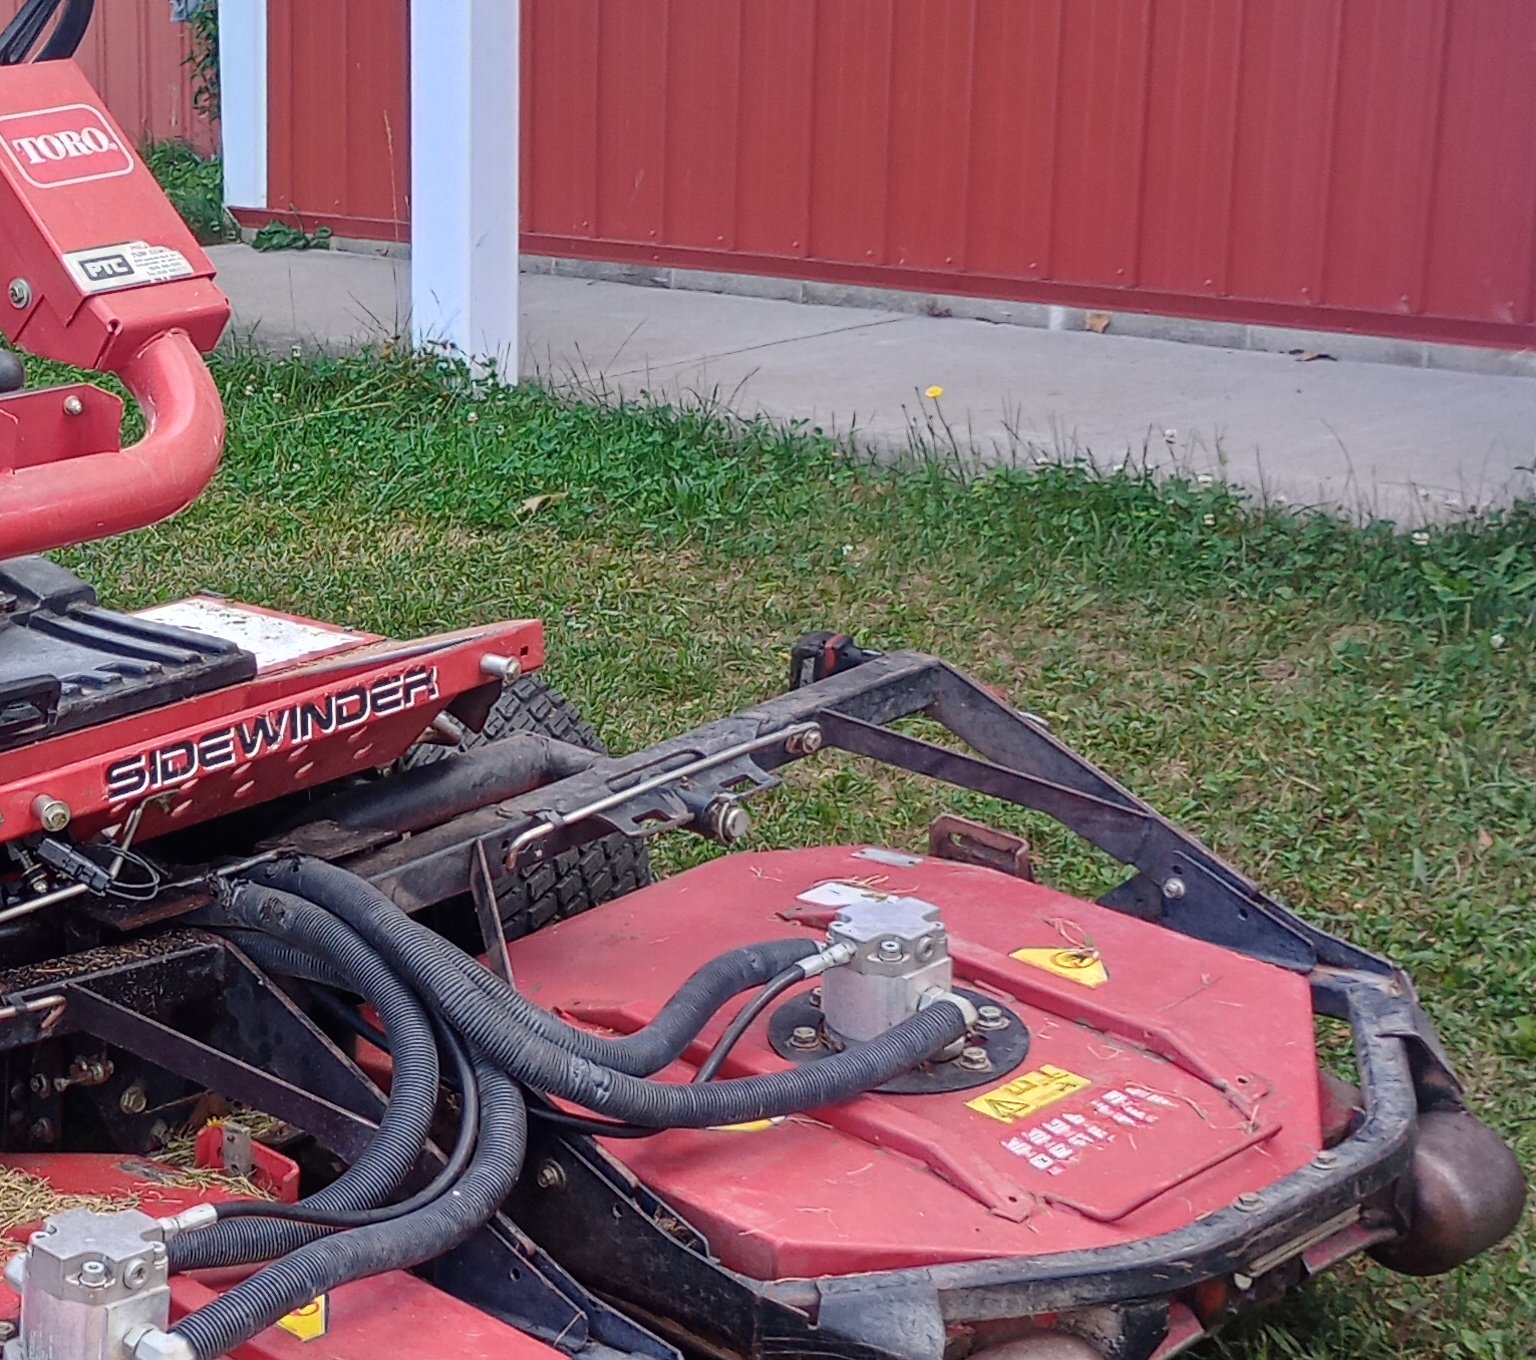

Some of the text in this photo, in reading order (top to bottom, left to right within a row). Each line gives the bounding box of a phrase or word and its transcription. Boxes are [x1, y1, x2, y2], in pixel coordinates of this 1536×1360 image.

[12, 126, 112, 165] TORO
[83, 257, 129, 278] PTC
[105, 664, 441, 803] SIDEWINDER
